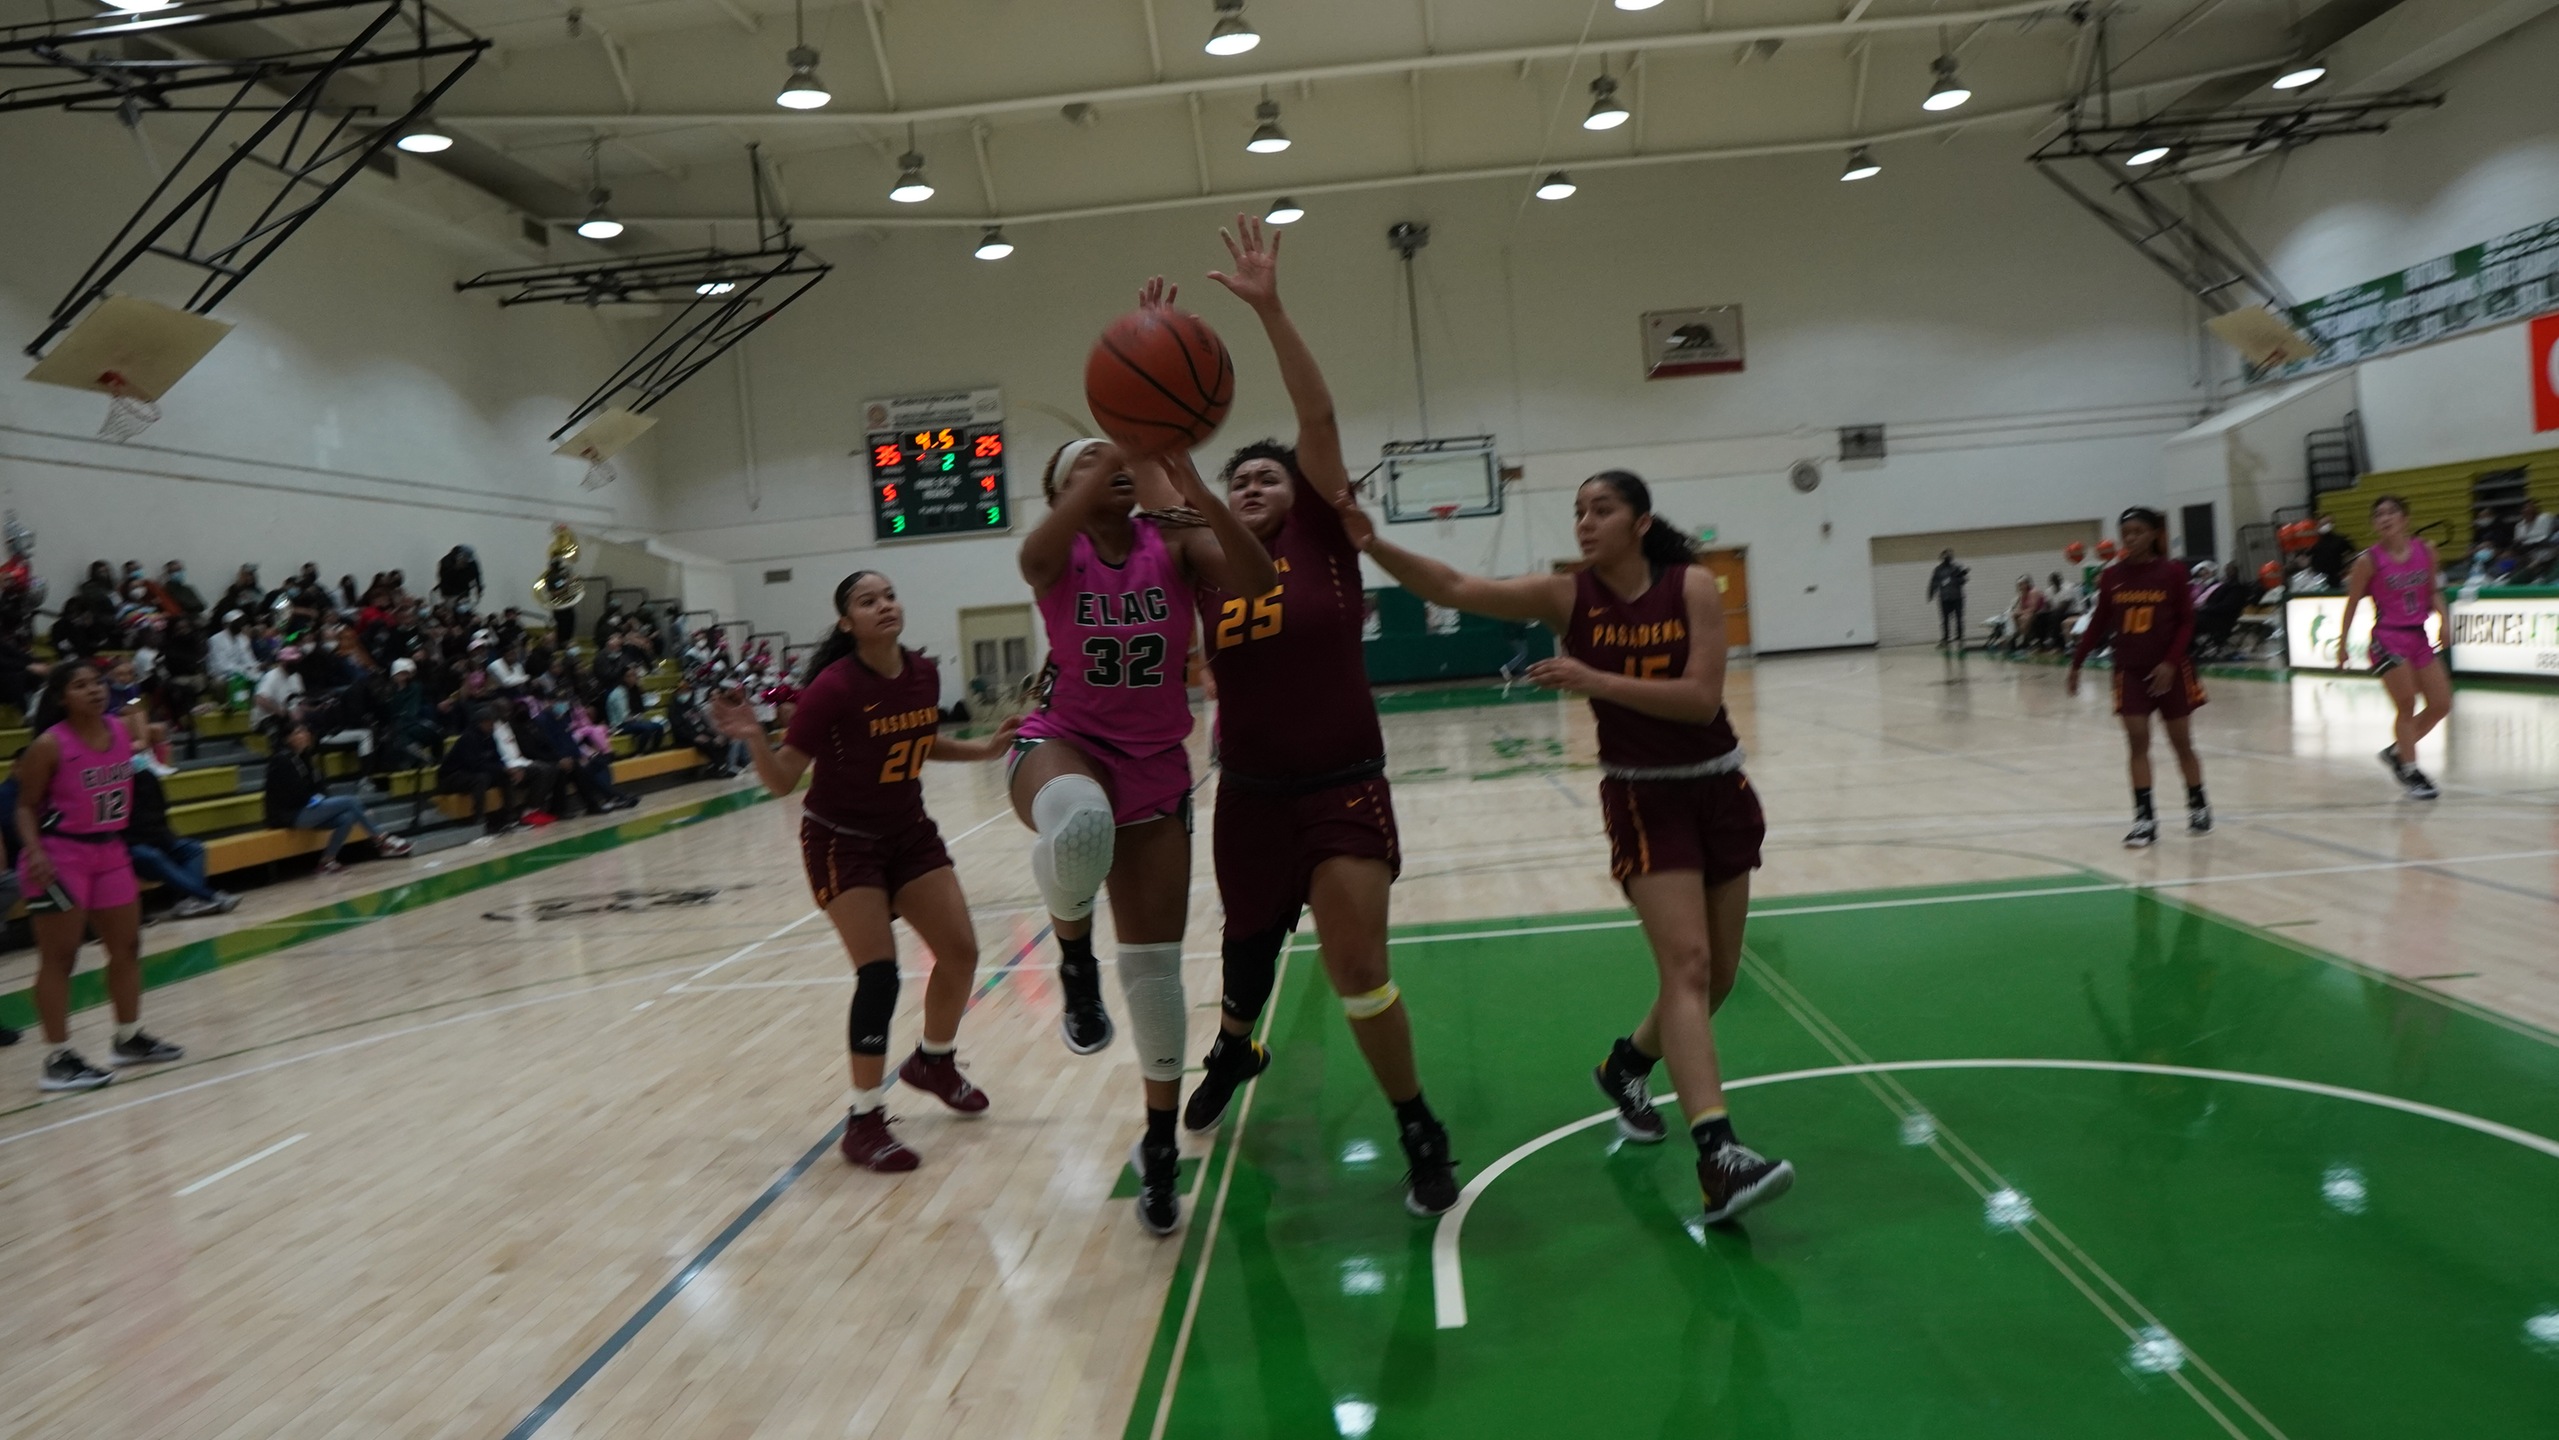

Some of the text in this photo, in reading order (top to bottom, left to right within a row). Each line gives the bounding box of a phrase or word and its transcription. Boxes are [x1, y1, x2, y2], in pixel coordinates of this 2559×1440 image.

[941, 453, 956, 471] 2
[891, 514, 906, 533] 3
[986, 506, 1000, 525] 3
[1074, 586, 1171, 627] ELAC
[1215, 583, 1284, 650] 25
[2121, 605, 2156, 635] 10
[1082, 632, 1168, 689] 32
[878, 733, 938, 784] 20
[93, 788, 128, 824] 12
